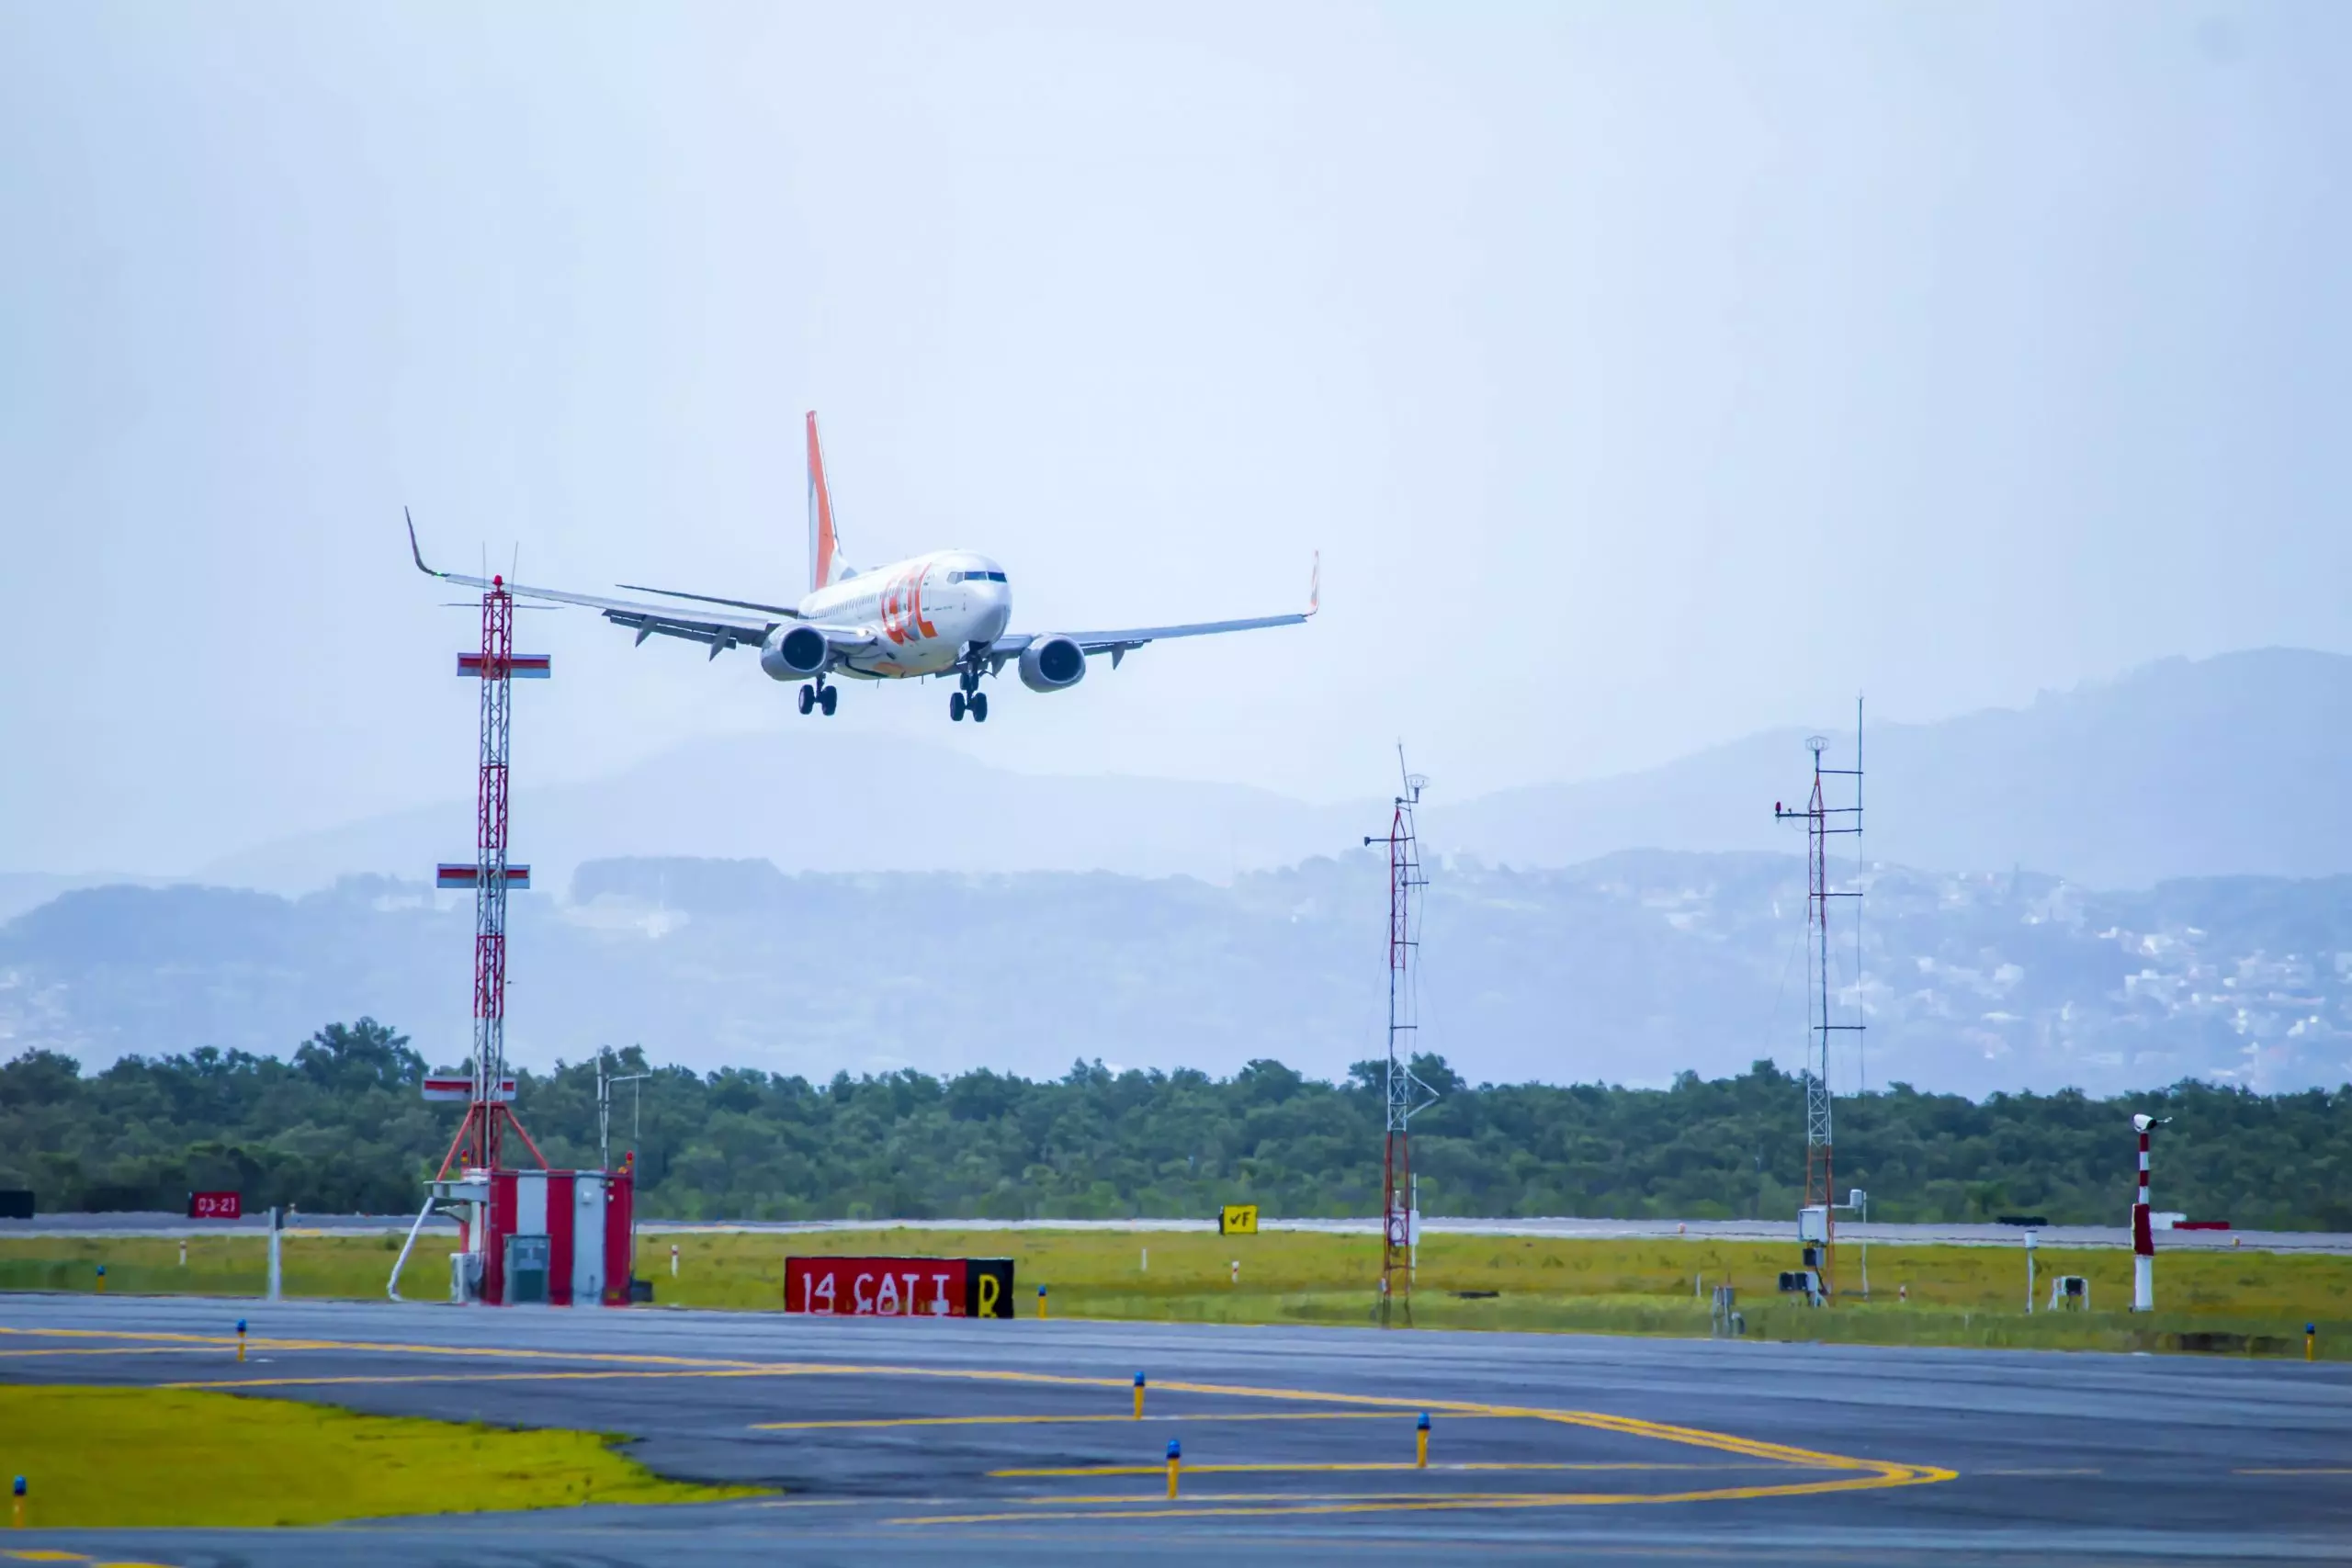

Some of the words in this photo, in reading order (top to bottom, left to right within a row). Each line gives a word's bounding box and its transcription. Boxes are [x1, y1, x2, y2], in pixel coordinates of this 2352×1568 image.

[1242, 1211, 1251, 1227] F
[802, 1272, 836, 1314] 14
[854, 1272, 920, 1316] CAT
